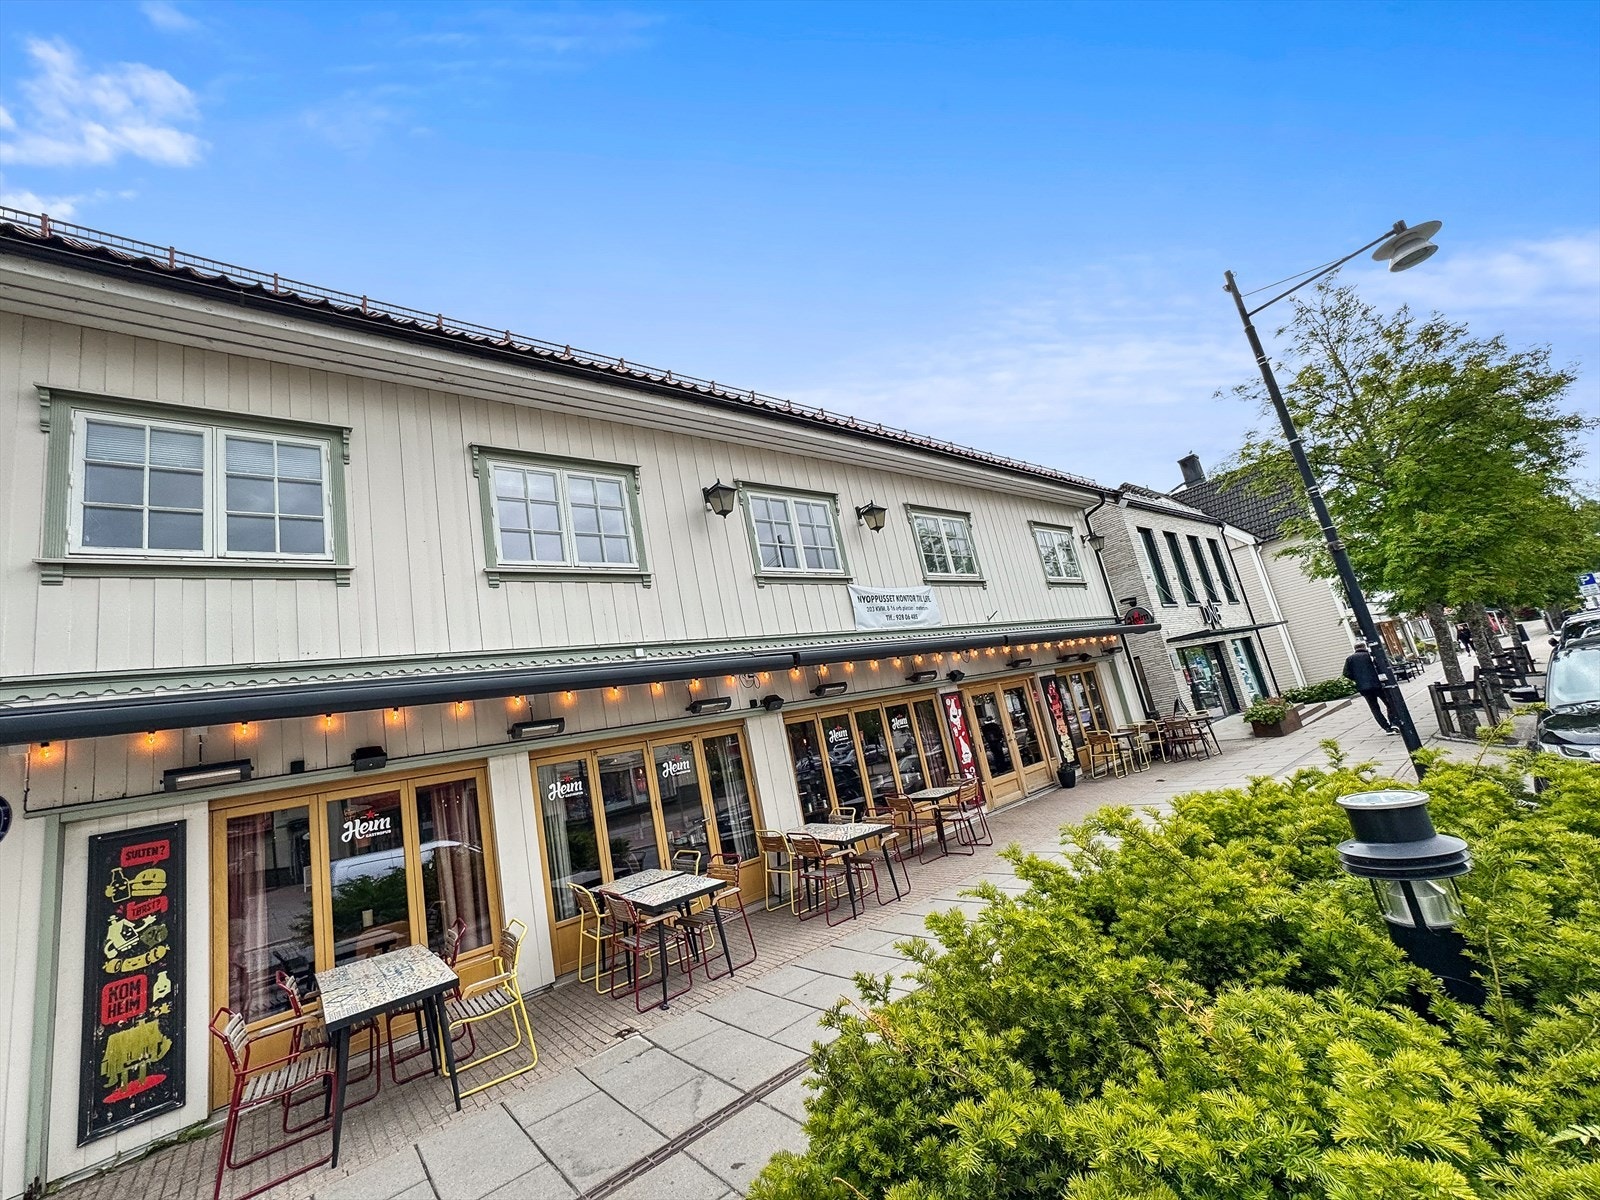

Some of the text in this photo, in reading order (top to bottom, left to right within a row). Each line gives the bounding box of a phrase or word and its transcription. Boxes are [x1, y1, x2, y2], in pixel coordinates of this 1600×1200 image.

[857, 594, 895, 603] NYOPPUSSET
[896, 594, 915, 602] KONTOR
[893, 717, 908, 730] Heim
[828, 729, 848, 743] Heim
[662, 760, 690, 778] Heim
[548, 780, 583, 801] Heim
[341, 816, 391, 843] Heim
[132, 899, 161, 917] TØRST?
[108, 978, 141, 1003] KOM
[107, 999, 141, 1019] HEIM
